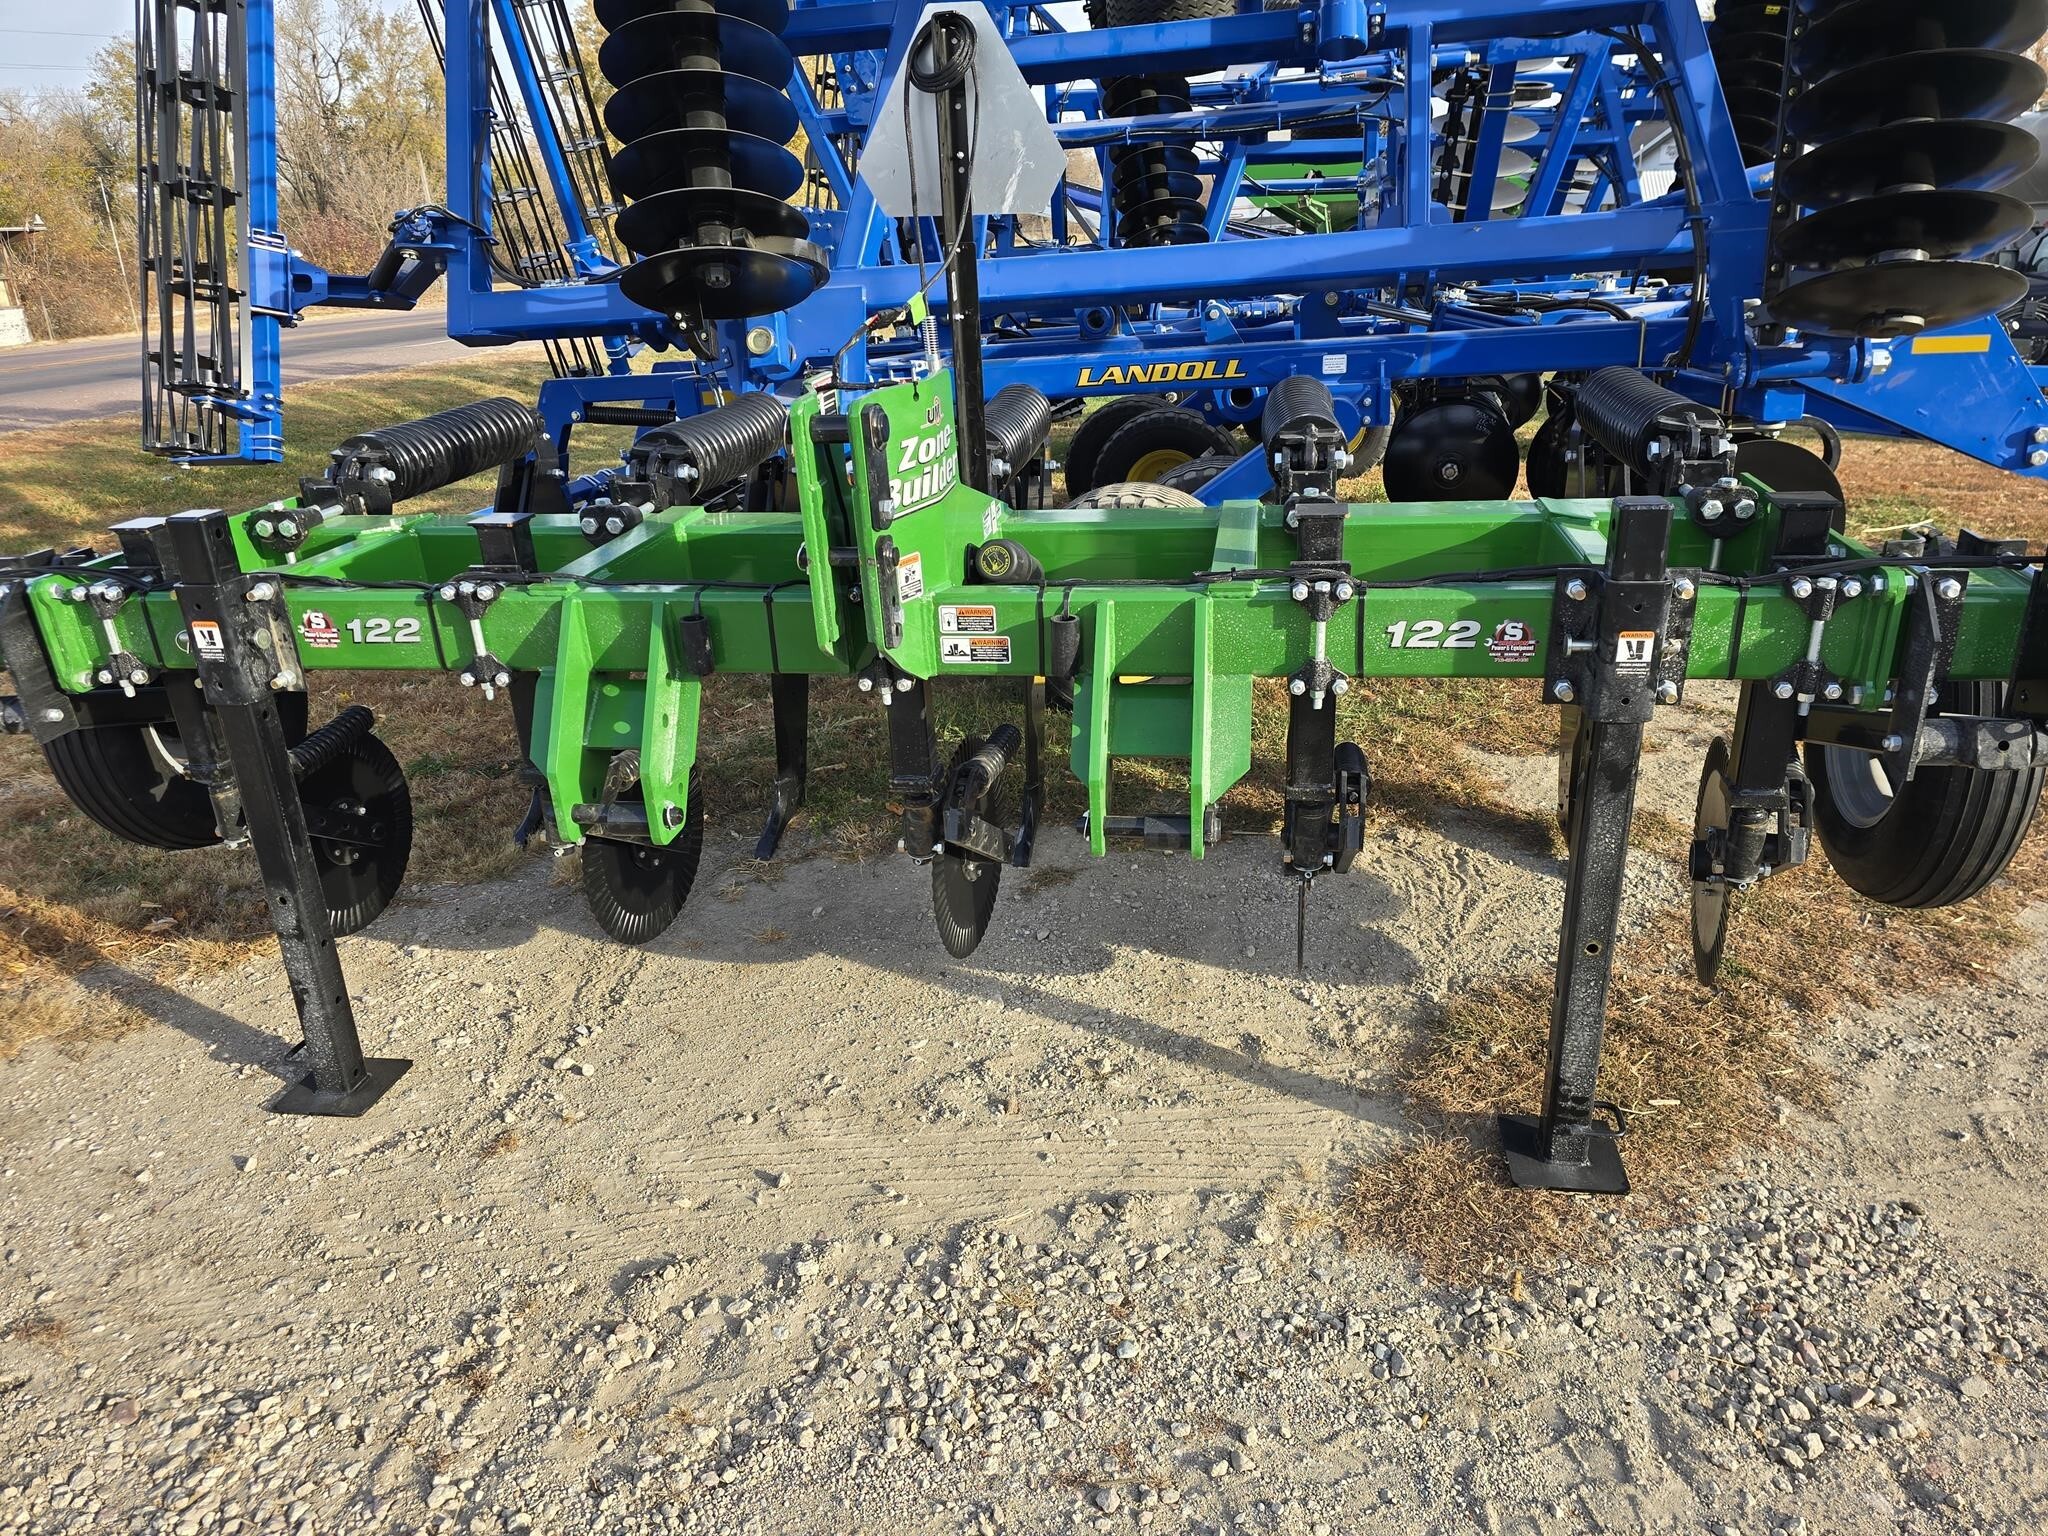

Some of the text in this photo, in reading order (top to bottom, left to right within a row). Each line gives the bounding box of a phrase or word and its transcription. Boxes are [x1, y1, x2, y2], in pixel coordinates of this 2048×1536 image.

[1077, 359, 1247, 387] LANDOLL
[889, 452, 958, 510] Builder
[345, 617, 421, 644] 122
[1385, 620, 1482, 649] 122
[1503, 622, 1524, 640] S
